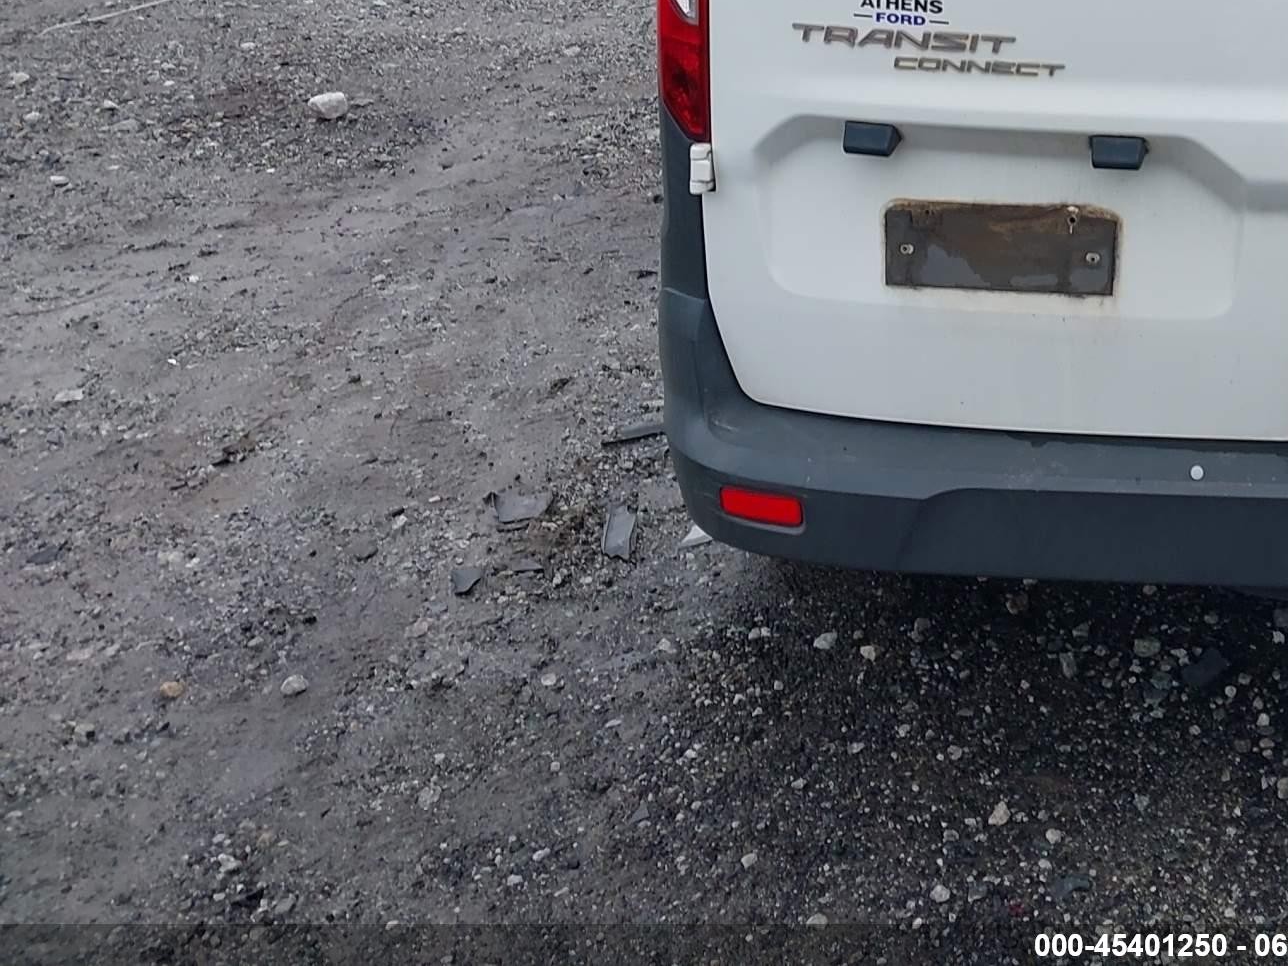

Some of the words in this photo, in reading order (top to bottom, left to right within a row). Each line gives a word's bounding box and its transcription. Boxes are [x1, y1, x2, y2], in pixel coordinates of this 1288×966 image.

[875, 11, 926, 26] FORD
[791, 22, 1017, 55] TRANSIT
[893, 56, 1066, 77] CONNECT
